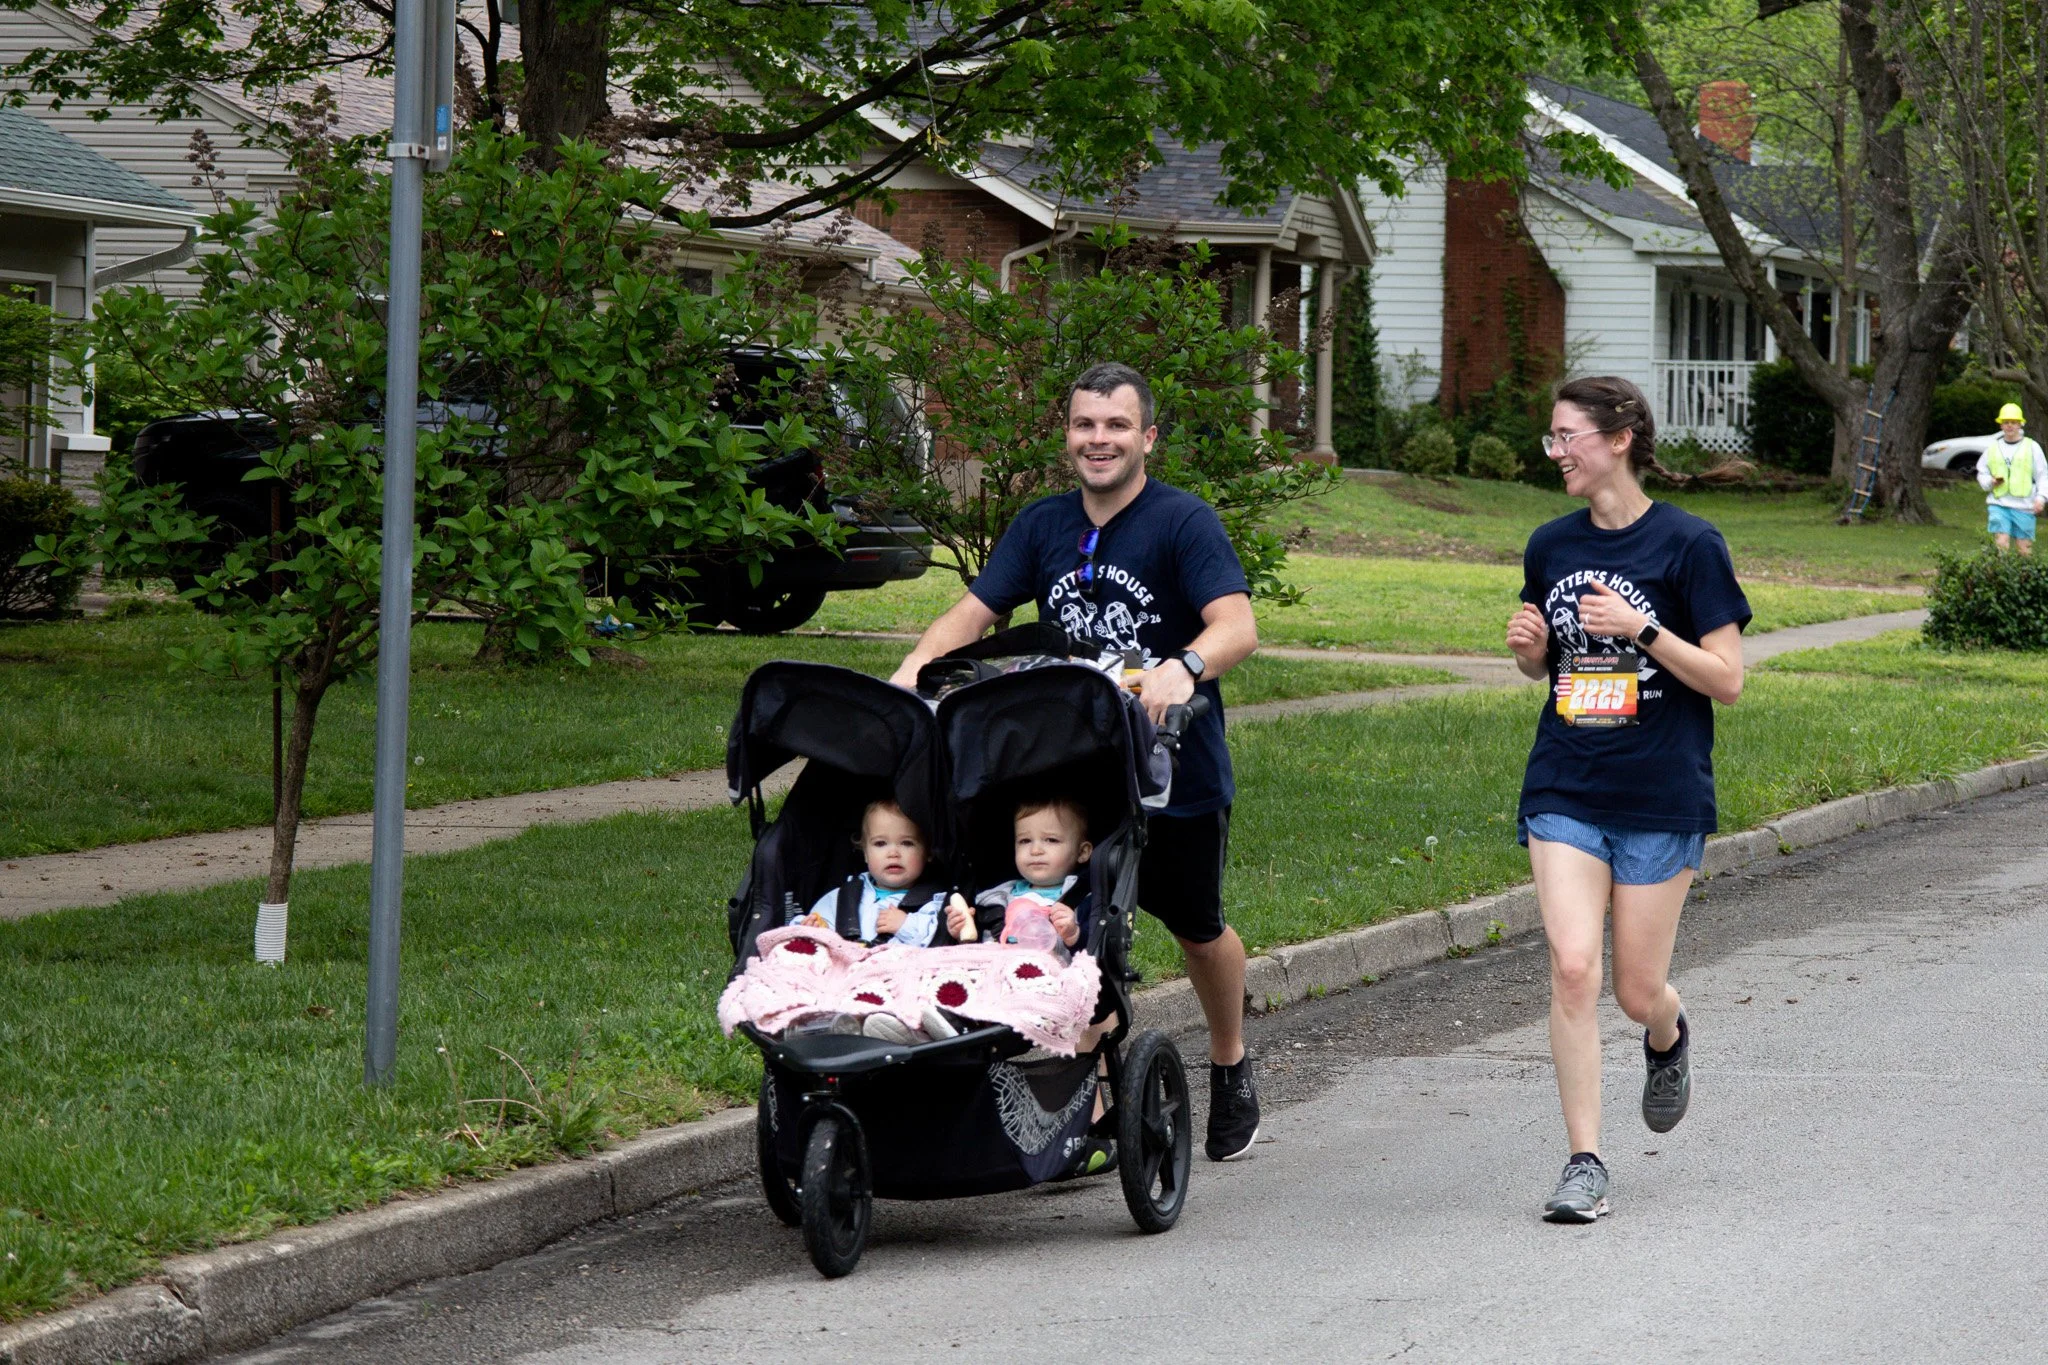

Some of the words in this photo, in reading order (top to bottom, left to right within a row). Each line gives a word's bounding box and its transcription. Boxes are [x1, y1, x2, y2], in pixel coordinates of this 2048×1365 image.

[1106, 565, 1155, 606] HOUSE
[1545, 569, 1608, 613] POTTER'S
[1568, 678, 1628, 710] 2225
[1643, 689, 1663, 700] RUN
